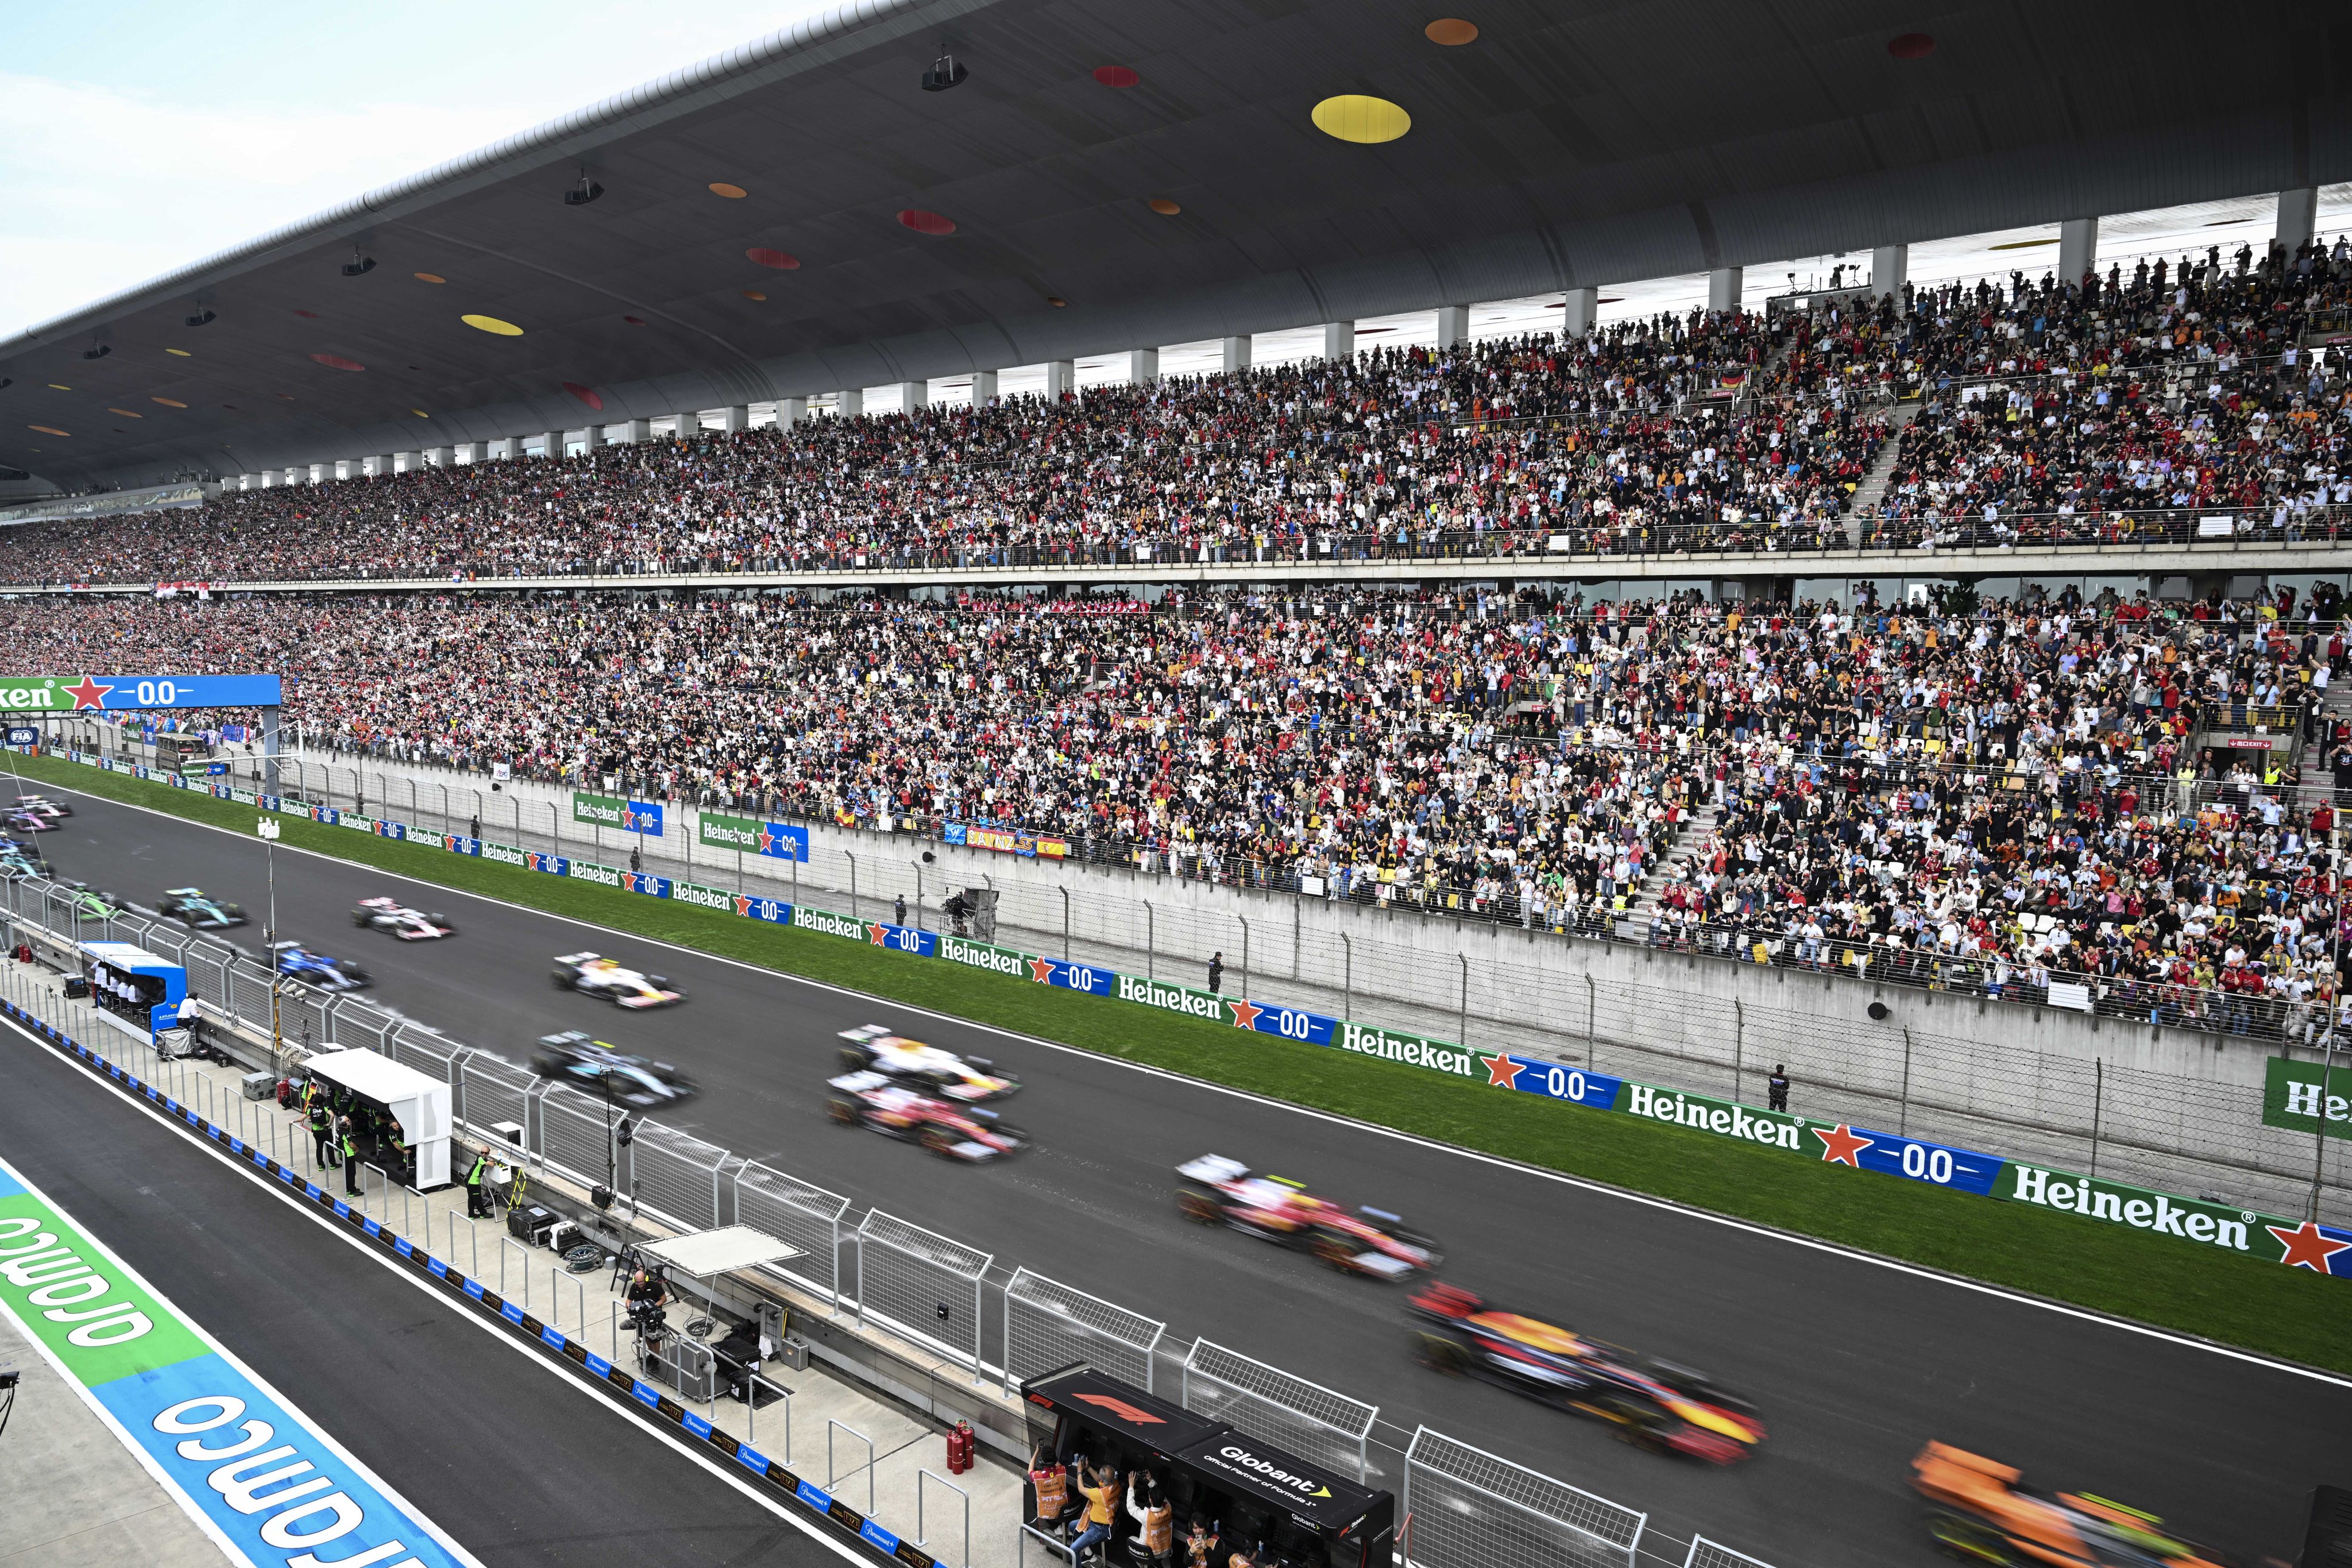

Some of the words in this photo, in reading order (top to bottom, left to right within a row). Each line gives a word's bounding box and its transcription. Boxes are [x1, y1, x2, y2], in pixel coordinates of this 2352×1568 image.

[11, 732, 31, 741] FIA
[231, 789, 255, 805] Heineken
[281, 800, 308, 818] Heineken
[577, 801, 619, 821] Heineken
[339, 813, 371, 832] Heineken
[406, 827, 442, 848] Heineken
[704, 822, 755, 845] Heineken
[969, 830, 1014, 850] SAINZ
[482, 843, 524, 866] Heineken
[570, 861, 619, 886] Heineken
[673, 882, 730, 910] Heineken
[795, 907, 863, 940] Heineken
[941, 937, 1022, 976] Heineken
[1119, 975, 1221, 1019] Heineken
[1342, 1023, 1472, 1076] Heineken
[2285, 1080, 2352, 1123] He
[1629, 1084, 1800, 1150] Heineken
[2013, 1164, 2249, 1250] Heineken
[544, 1330, 563, 1346] Paramount+
[588, 1357, 608, 1373] Paramount+
[635, 1384, 656, 1402] Paramount+
[685, 1415, 709, 1434] Paramount+
[724, 1439, 736, 1452] 1923
[740, 1449, 766, 1468] Paramount+
[1220, 1446, 1315, 1492] Globant
[152, 1396, 429, 1568] ramco
[782, 1474, 794, 1489] 1923
[1204, 1455, 1232, 1469] Official
[1231, 1466, 1262, 1482] Partner
[1271, 1485, 1306, 1504] Formula
[801, 1485, 828, 1507] Paramount+
[845, 1513, 859, 1528] 1923
[1292, 1513, 1316, 1529] Globant
[864, 1524, 894, 1547] Paramount+
[914, 1555, 929, 1568] 1923
[1128, 1546, 1145, 1557] Globant
